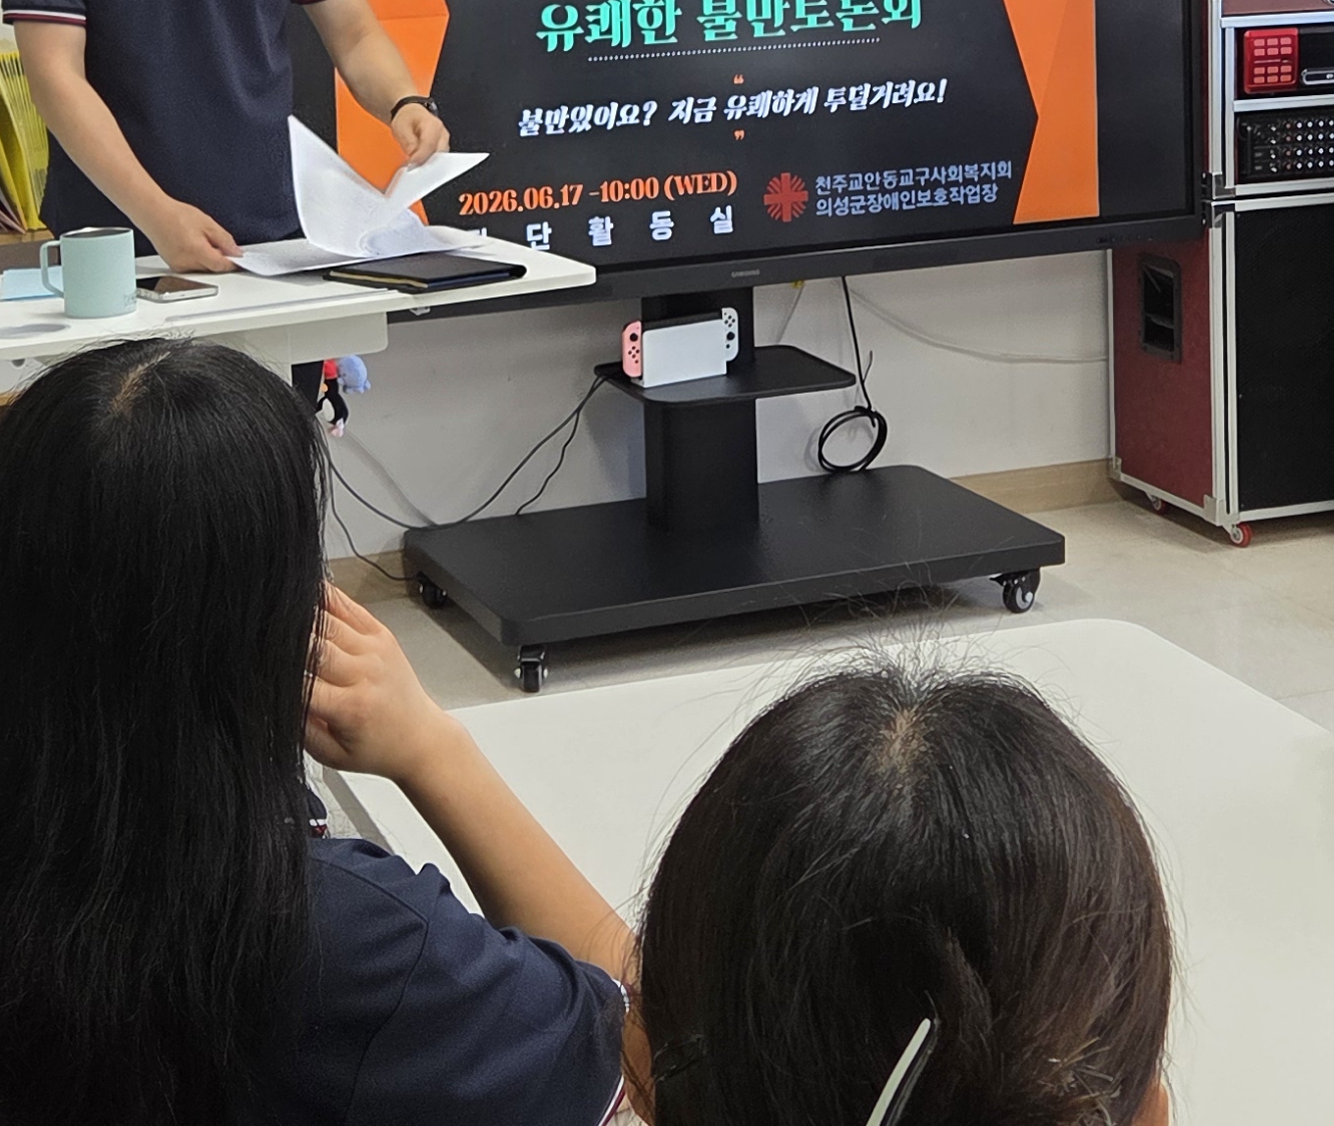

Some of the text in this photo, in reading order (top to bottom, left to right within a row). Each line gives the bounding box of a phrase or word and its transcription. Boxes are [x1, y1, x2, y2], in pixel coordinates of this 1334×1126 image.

[667, 95, 718, 125] 지금
[722, 87, 817, 121] 유쾌하게
[823, 77, 950, 114] 투덜거려요!
[457, 182, 584, 217] 2026.06.17
[663, 169, 739, 201] (WED)
[815, 159, 1013, 196] 천주교안동교구사회복지회
[815, 182, 999, 218] 의성군장애인보호작업장
